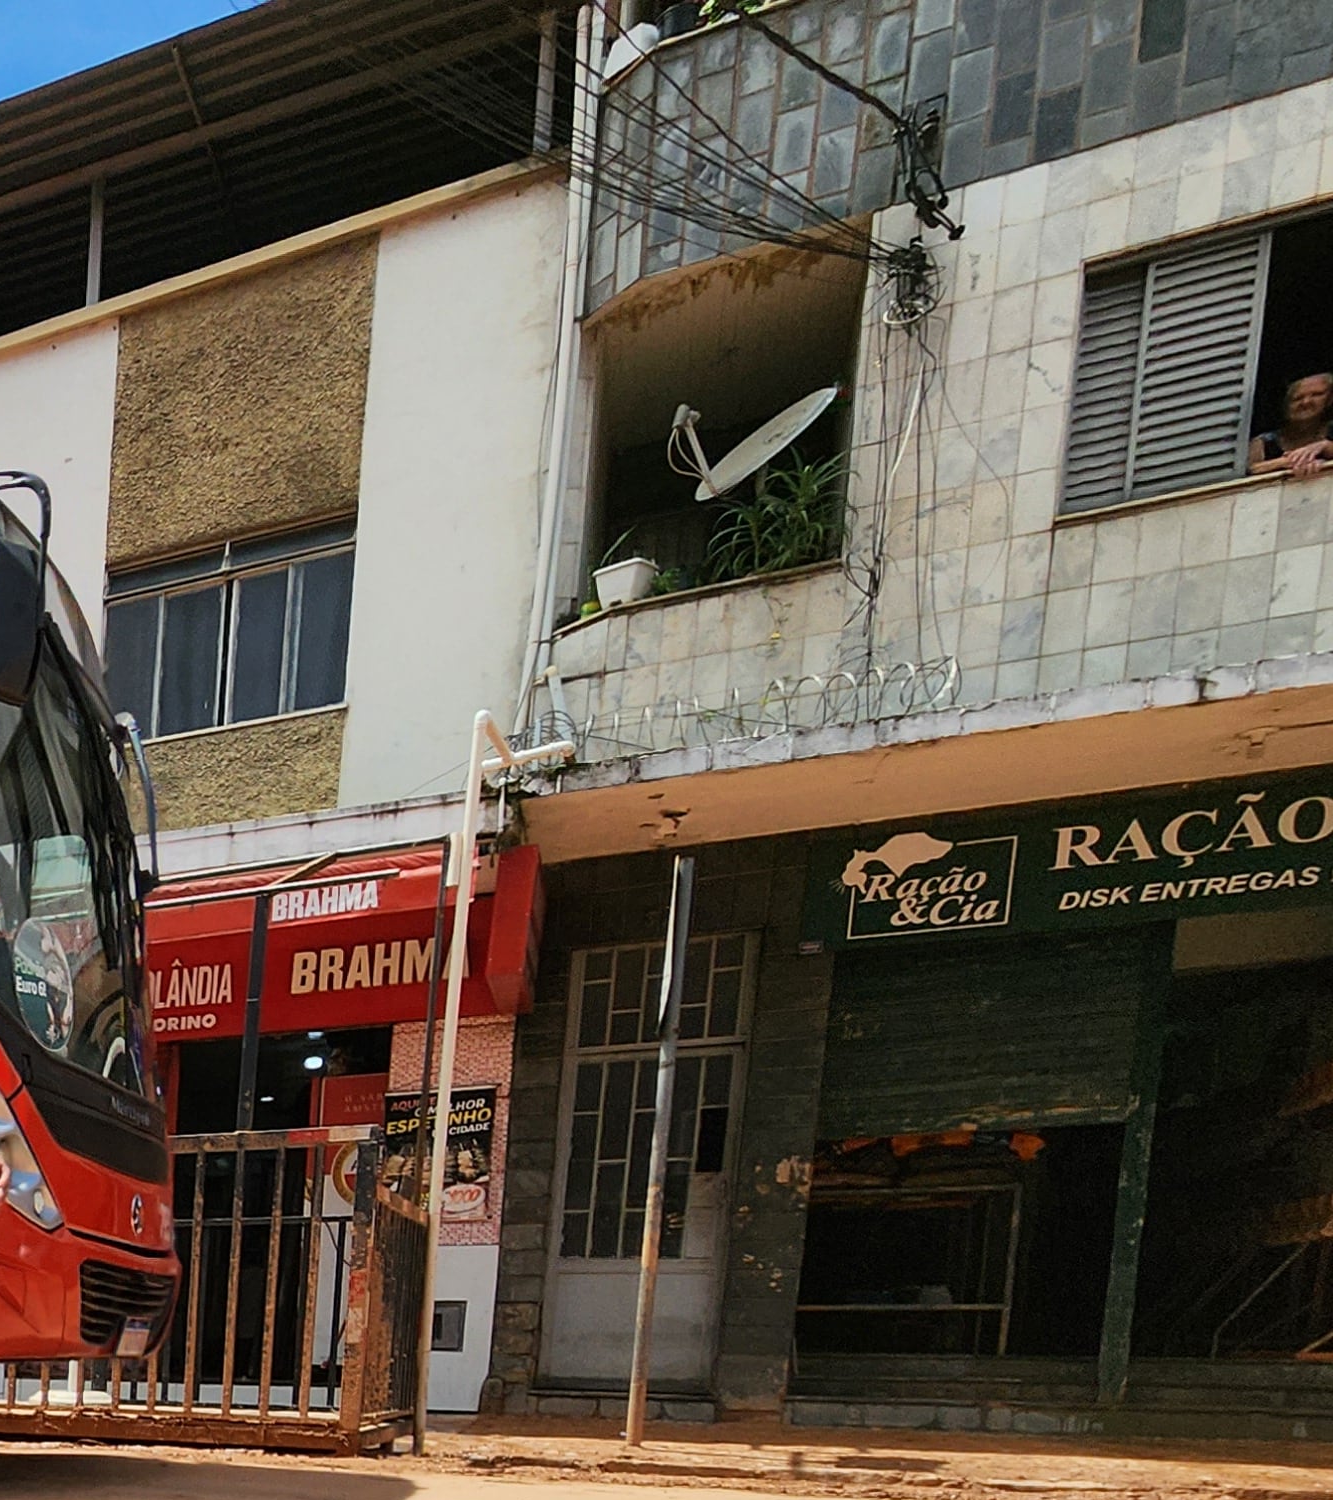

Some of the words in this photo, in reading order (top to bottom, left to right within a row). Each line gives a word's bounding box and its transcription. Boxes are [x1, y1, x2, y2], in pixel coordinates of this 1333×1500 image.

[1047, 791, 1333, 869] RAÇÃO
[271, 881, 379, 922] BRAHMA
[859, 865, 988, 904] Ração
[1058, 884, 1131, 911] DISK
[1138, 866, 1321, 903] ENTREGAS
[386, 1108, 491, 1135] ESPNHO
[427, 1098, 486, 1116] MLHOR
[449, 1122, 490, 1135] CIDADE
